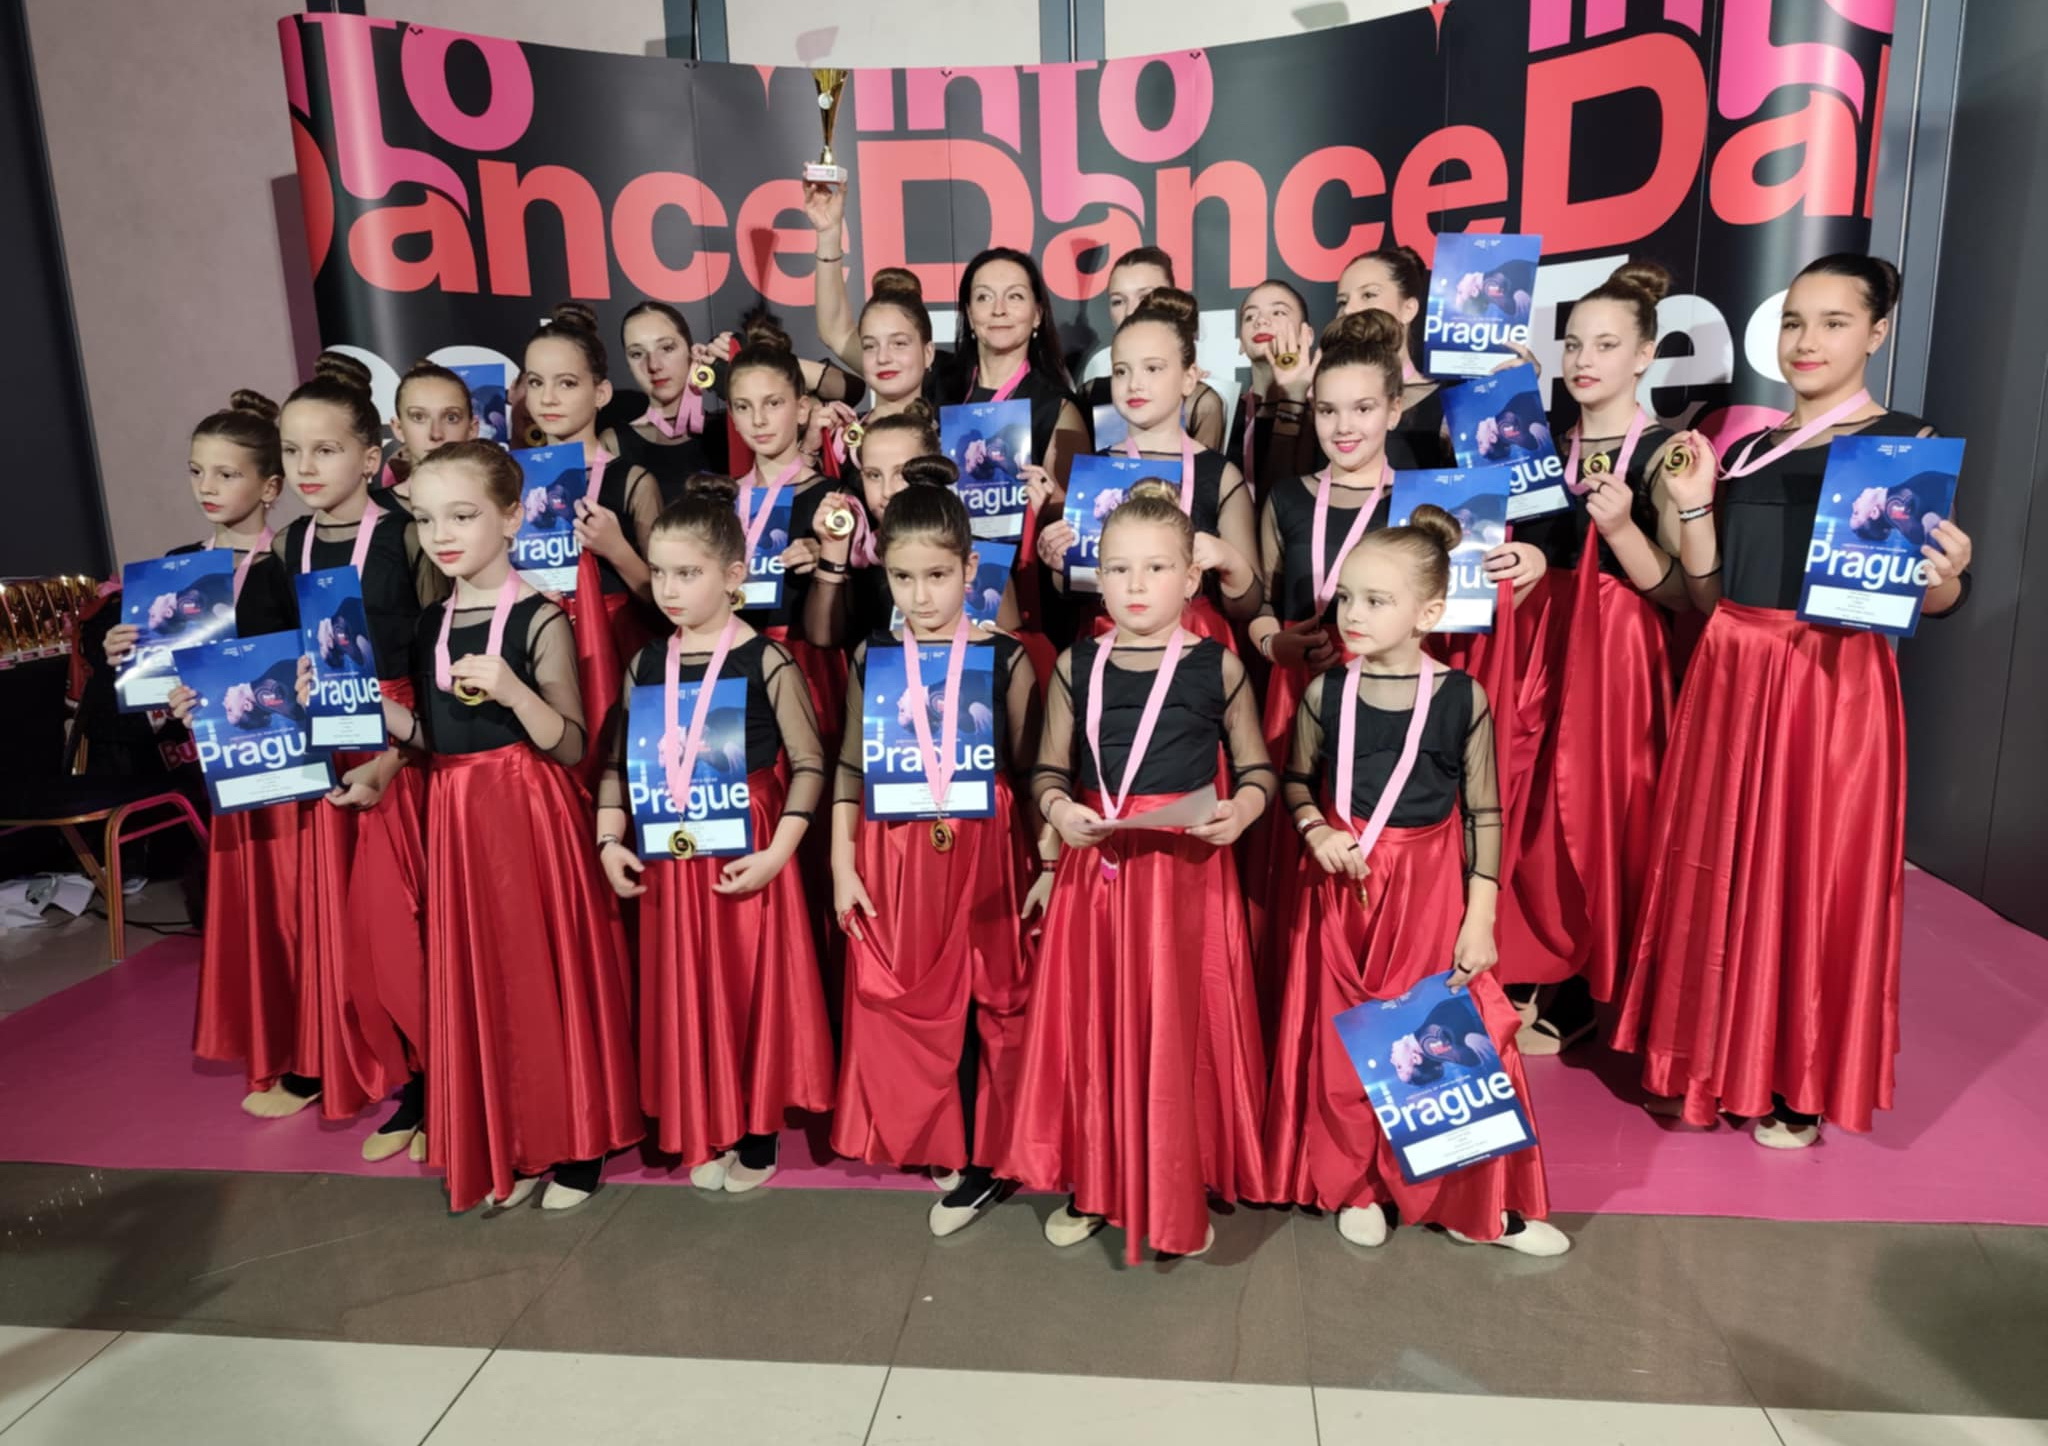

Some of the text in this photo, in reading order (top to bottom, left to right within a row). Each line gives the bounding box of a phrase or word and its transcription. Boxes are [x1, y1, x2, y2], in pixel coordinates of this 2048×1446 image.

[1424, 315, 1530, 350] Prague
[1804, 539, 1937, 590] Prague
[1374, 1071, 1516, 1140] Prague
